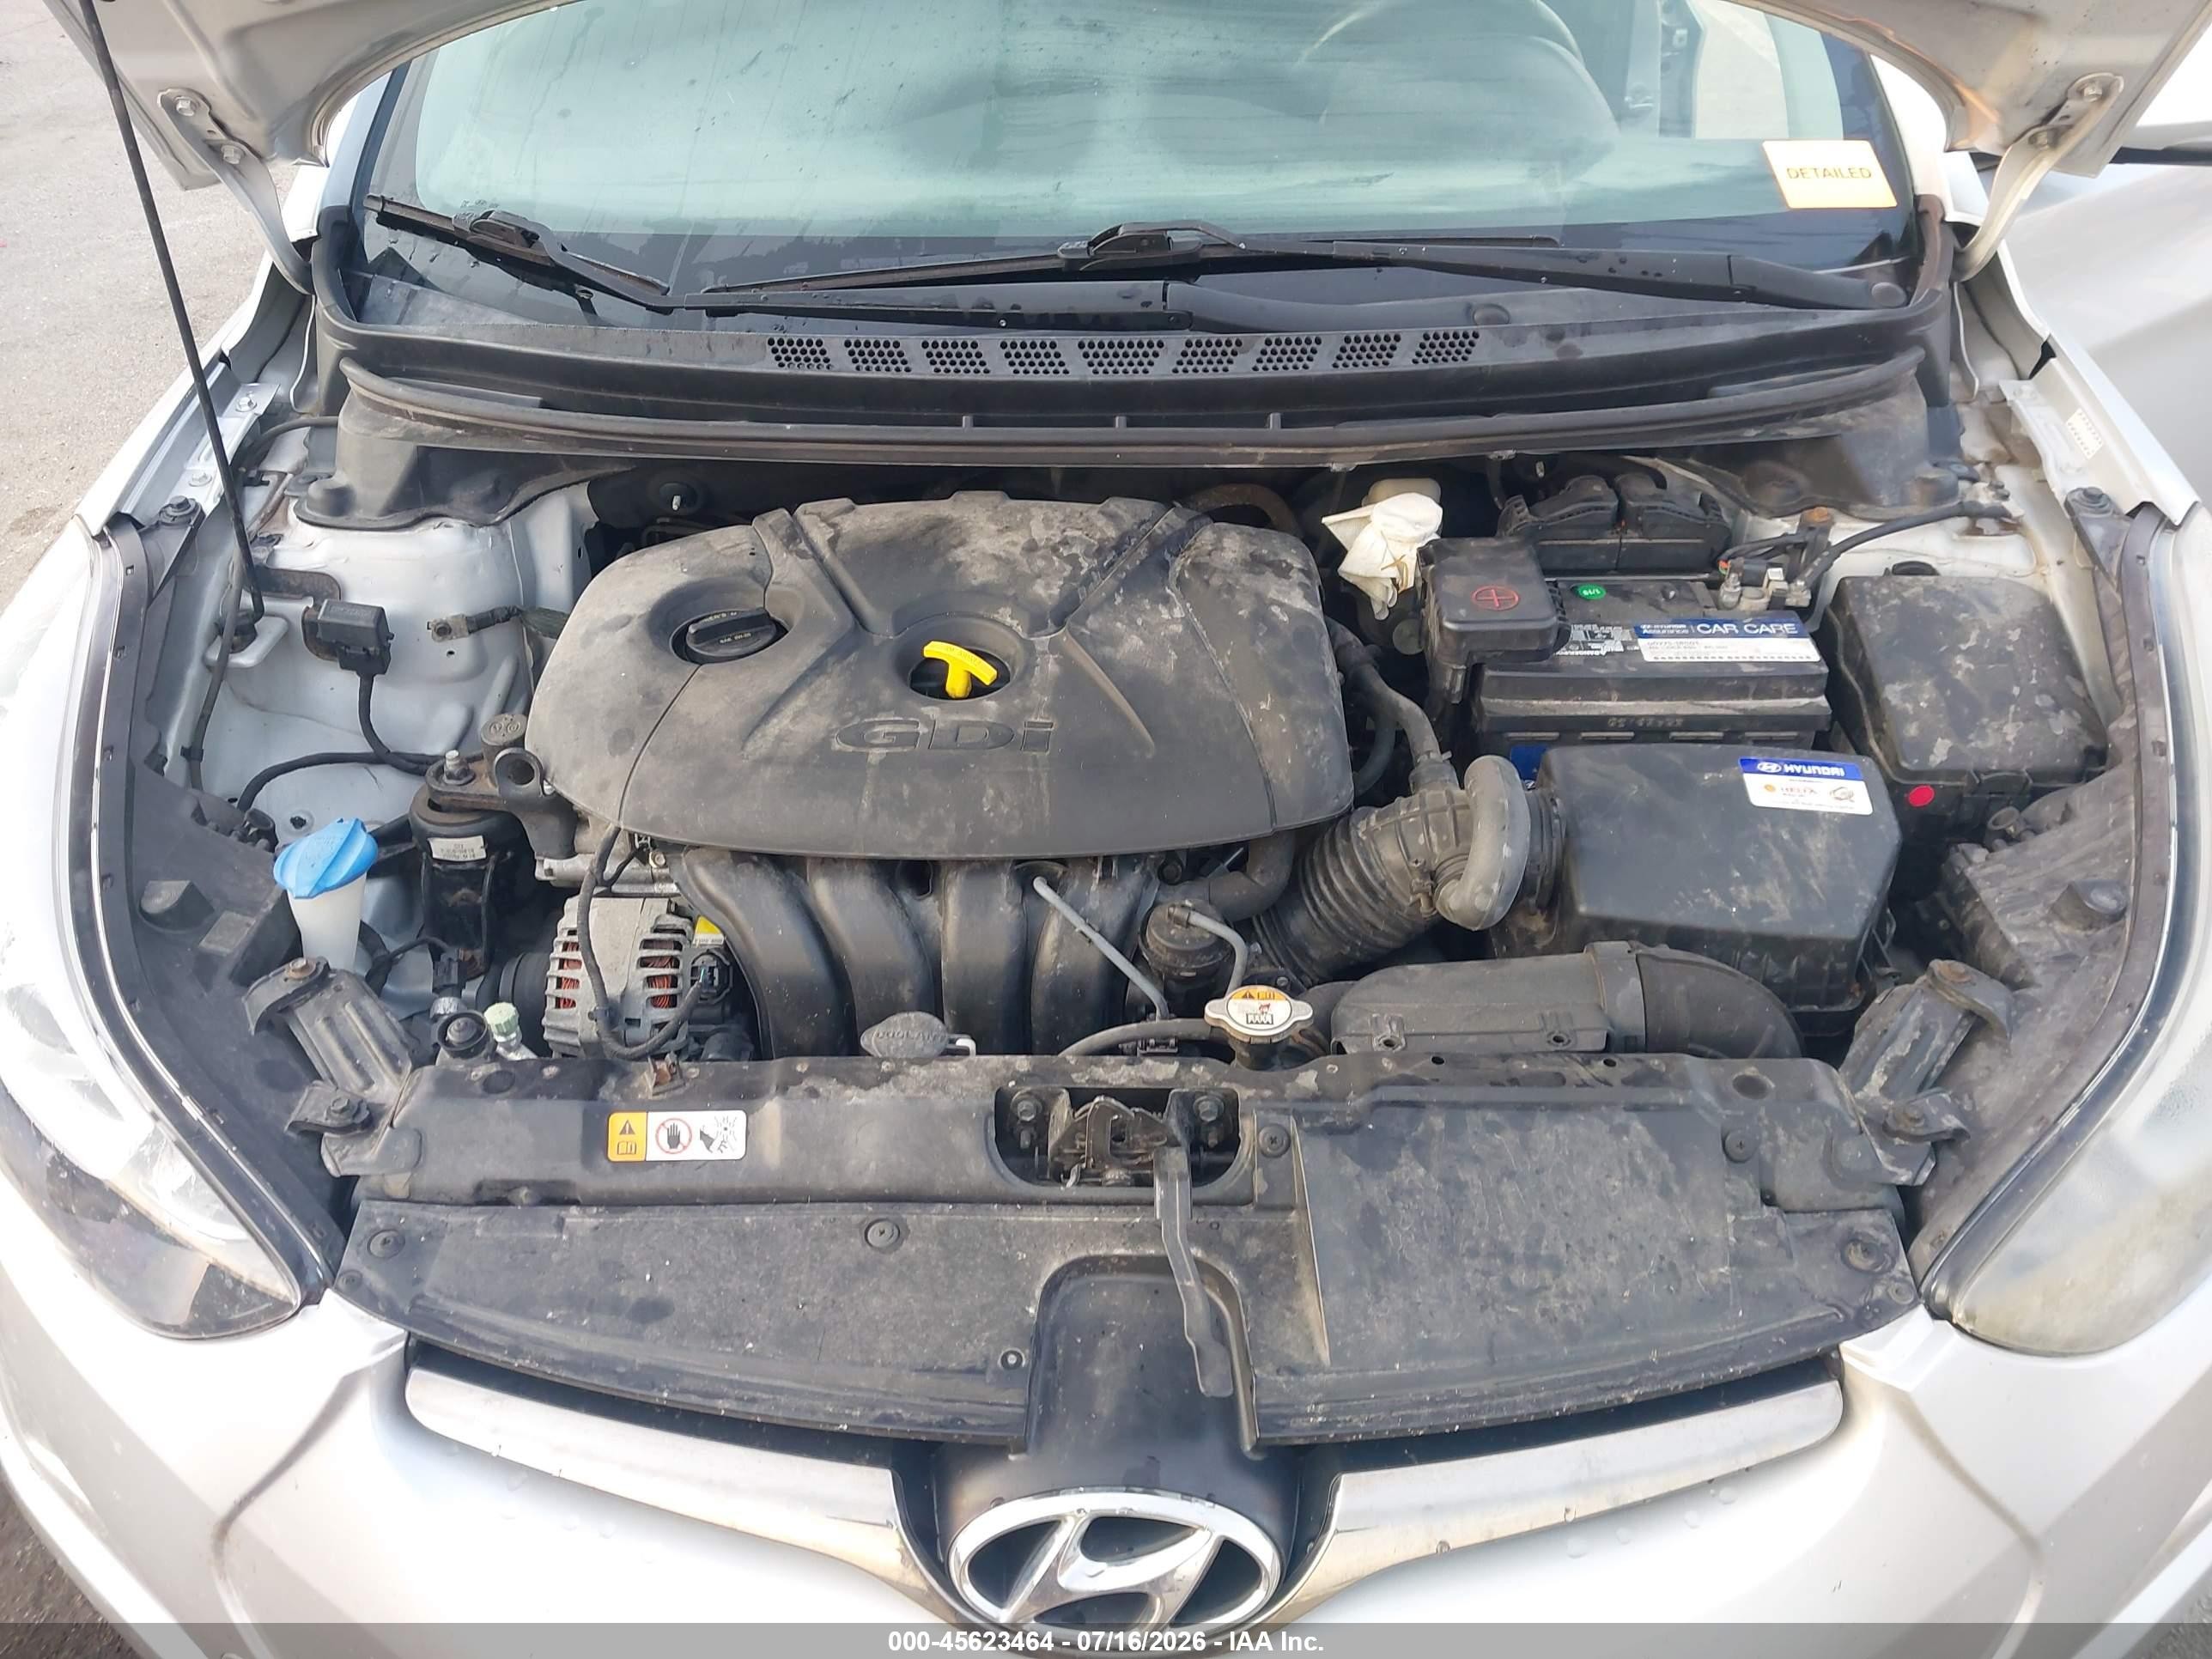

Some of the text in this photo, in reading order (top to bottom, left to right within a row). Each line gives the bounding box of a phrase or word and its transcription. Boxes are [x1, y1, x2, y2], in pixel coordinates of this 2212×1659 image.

[1785, 167, 1873, 179] DETAILED
[1696, 623, 1799, 635] CAR CARE
[1783, 763, 1846, 777] HYUNDAI
